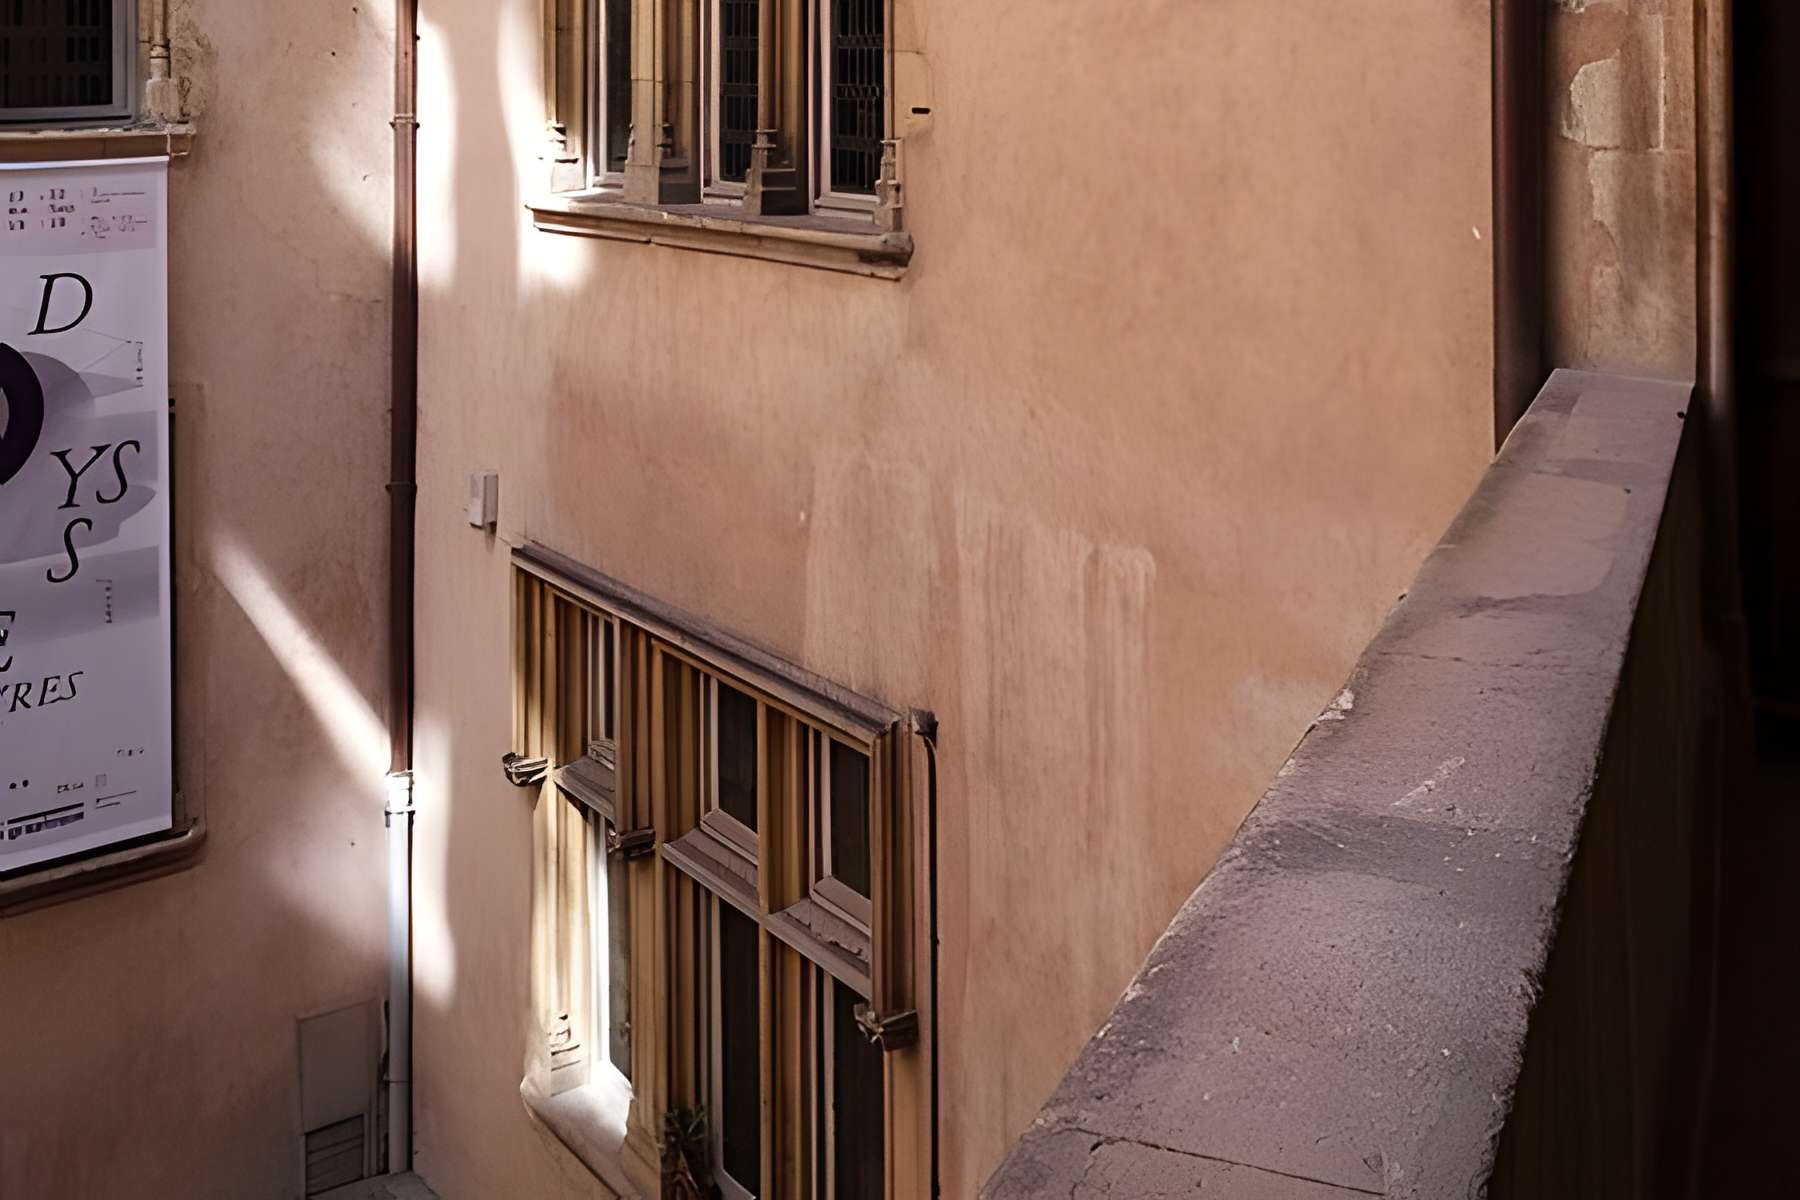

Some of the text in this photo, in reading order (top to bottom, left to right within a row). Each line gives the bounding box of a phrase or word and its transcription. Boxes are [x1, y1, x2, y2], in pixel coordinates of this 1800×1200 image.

[27, 272, 93, 335] D
[50, 440, 140, 510] YS
[46, 517, 92, 583] S
